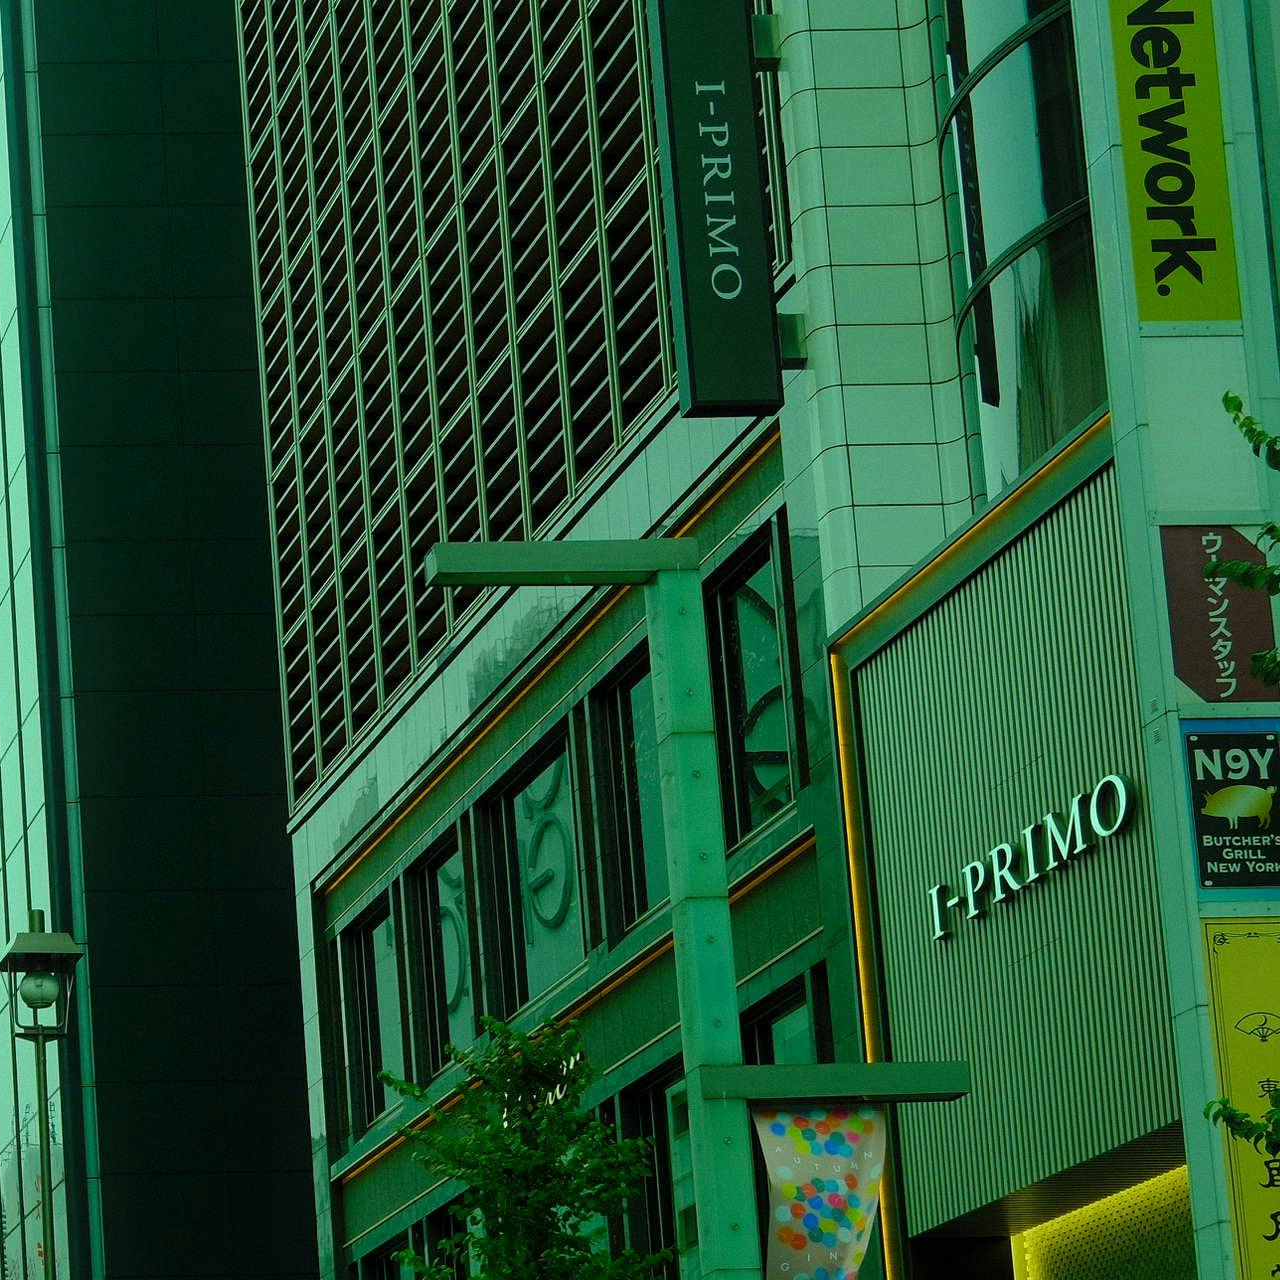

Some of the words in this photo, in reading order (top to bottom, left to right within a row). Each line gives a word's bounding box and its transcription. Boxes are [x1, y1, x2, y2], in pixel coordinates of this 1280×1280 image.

[694, 80, 743, 302] I-PRIMO
[1192, 748, 1276, 781] N9Y
[927, 773, 1136, 943] I-PRIMO
[1222, 848, 1267, 860] GRILL
